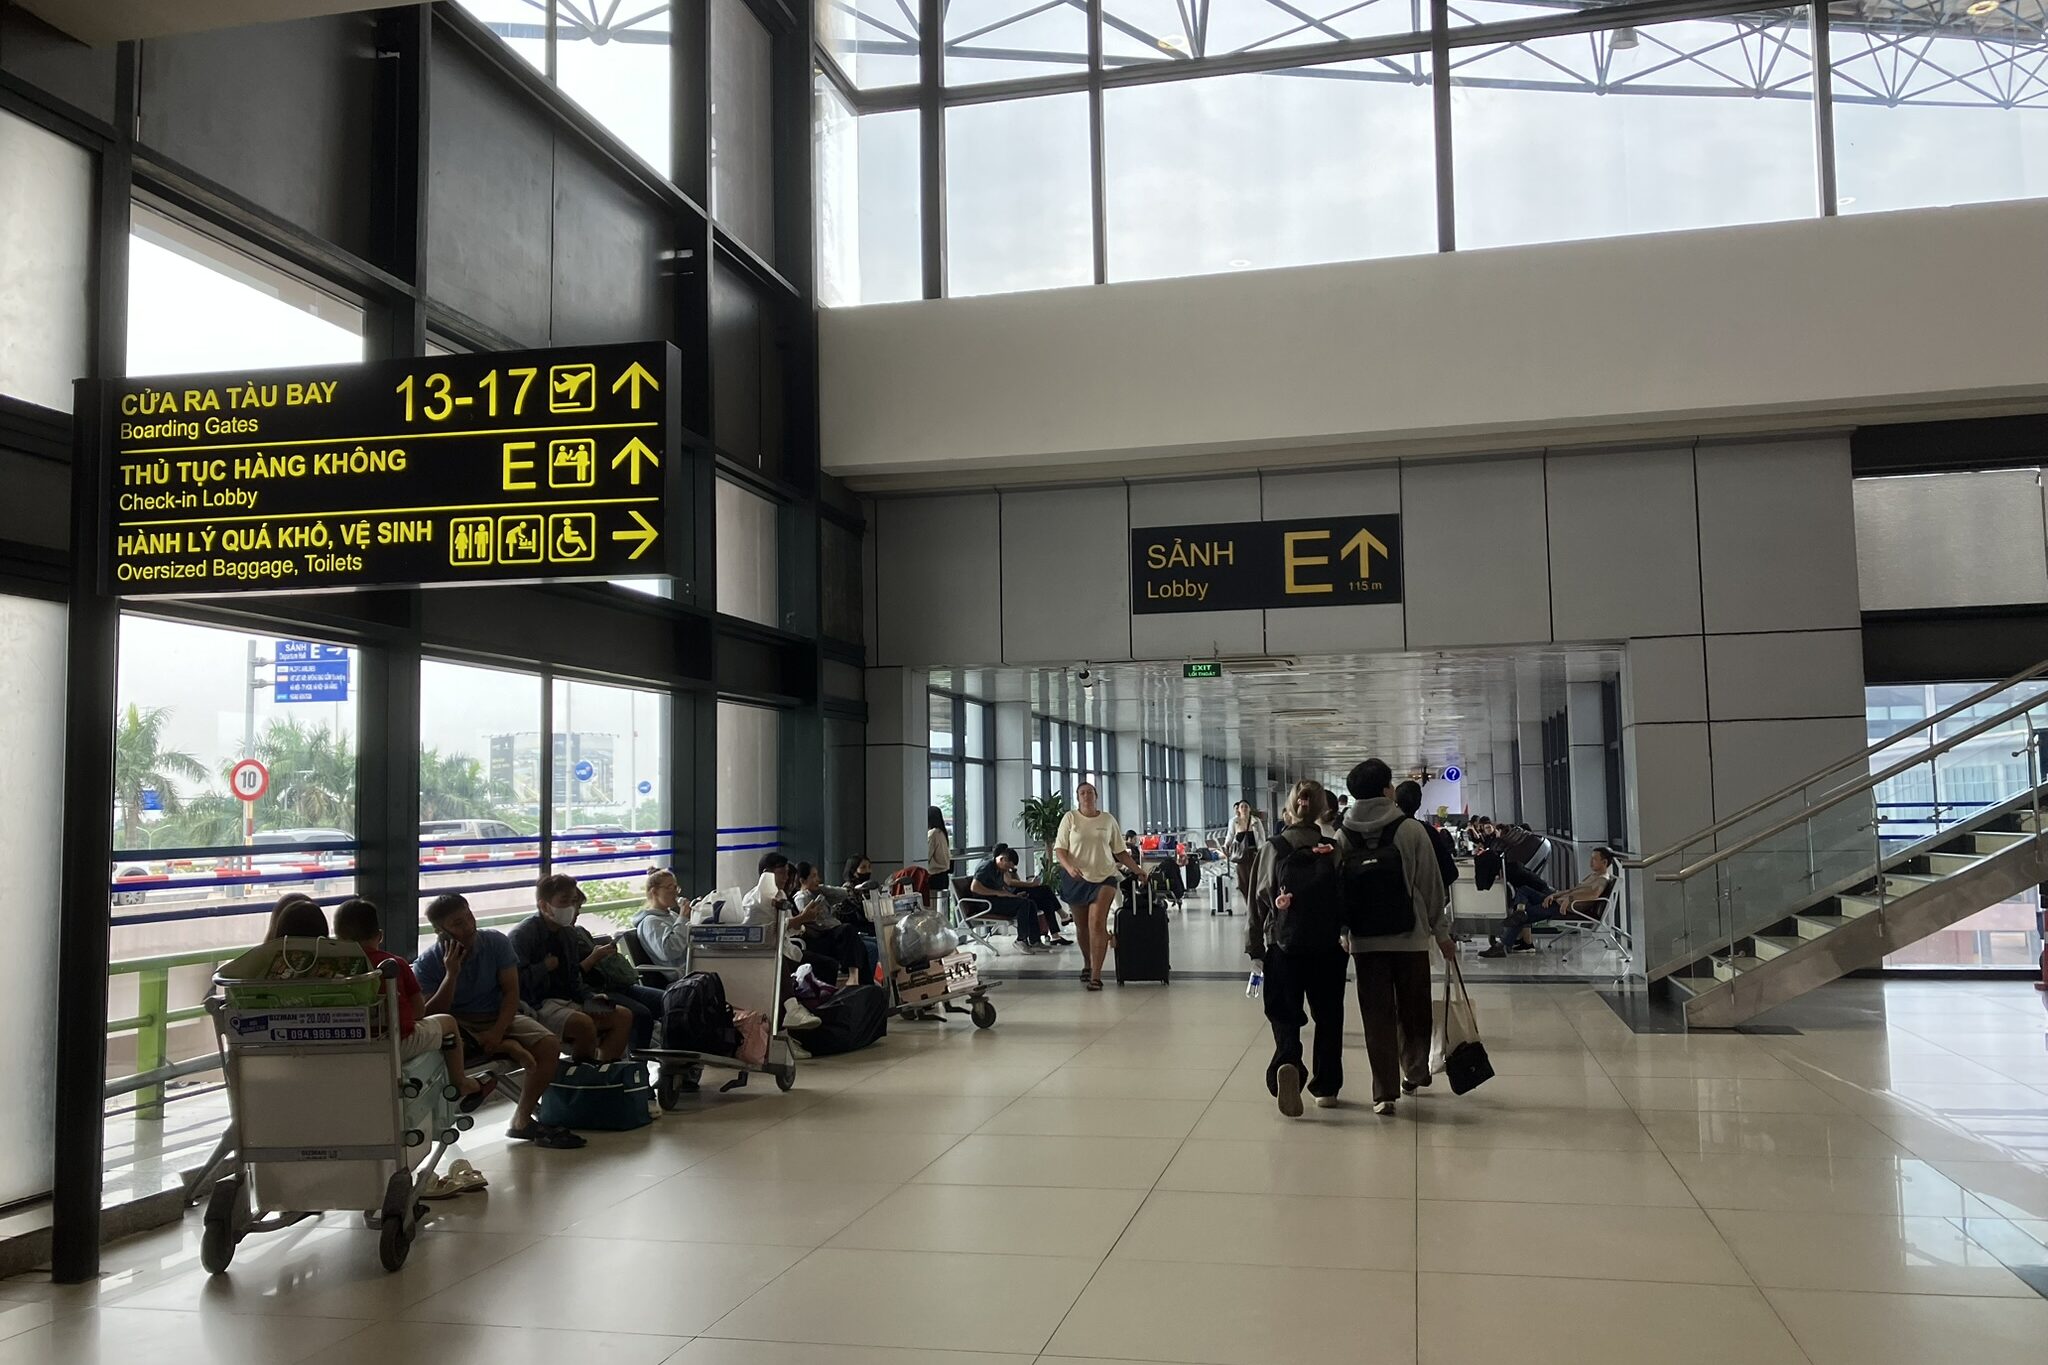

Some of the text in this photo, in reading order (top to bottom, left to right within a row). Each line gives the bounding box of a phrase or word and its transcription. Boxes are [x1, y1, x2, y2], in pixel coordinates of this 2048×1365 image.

[121, 381, 338, 416] CỬA RA TÀU BAY
[396, 367, 538, 422] 13-17
[120, 416, 259, 440] Boarding Gates
[120, 446, 406, 487] THỦ TỤC HÀNG KHÔNG
[502, 441, 537, 491] E
[119, 487, 258, 511] Check-in Lobby
[117, 519, 432, 556] HÀNH LÝ QUÁ KHỔ, VỆ SINH
[117, 553, 362, 581] Oversized Baggage, Toilets
[1147, 537, 1235, 570] SẢNH
[1283, 529, 1334, 594] E
[1147, 578, 1209, 601] Lobby
[1349, 580, 1382, 591] 115 m
[285, 641, 321, 659] SẢNH E
[240, 770, 257, 789] 10
